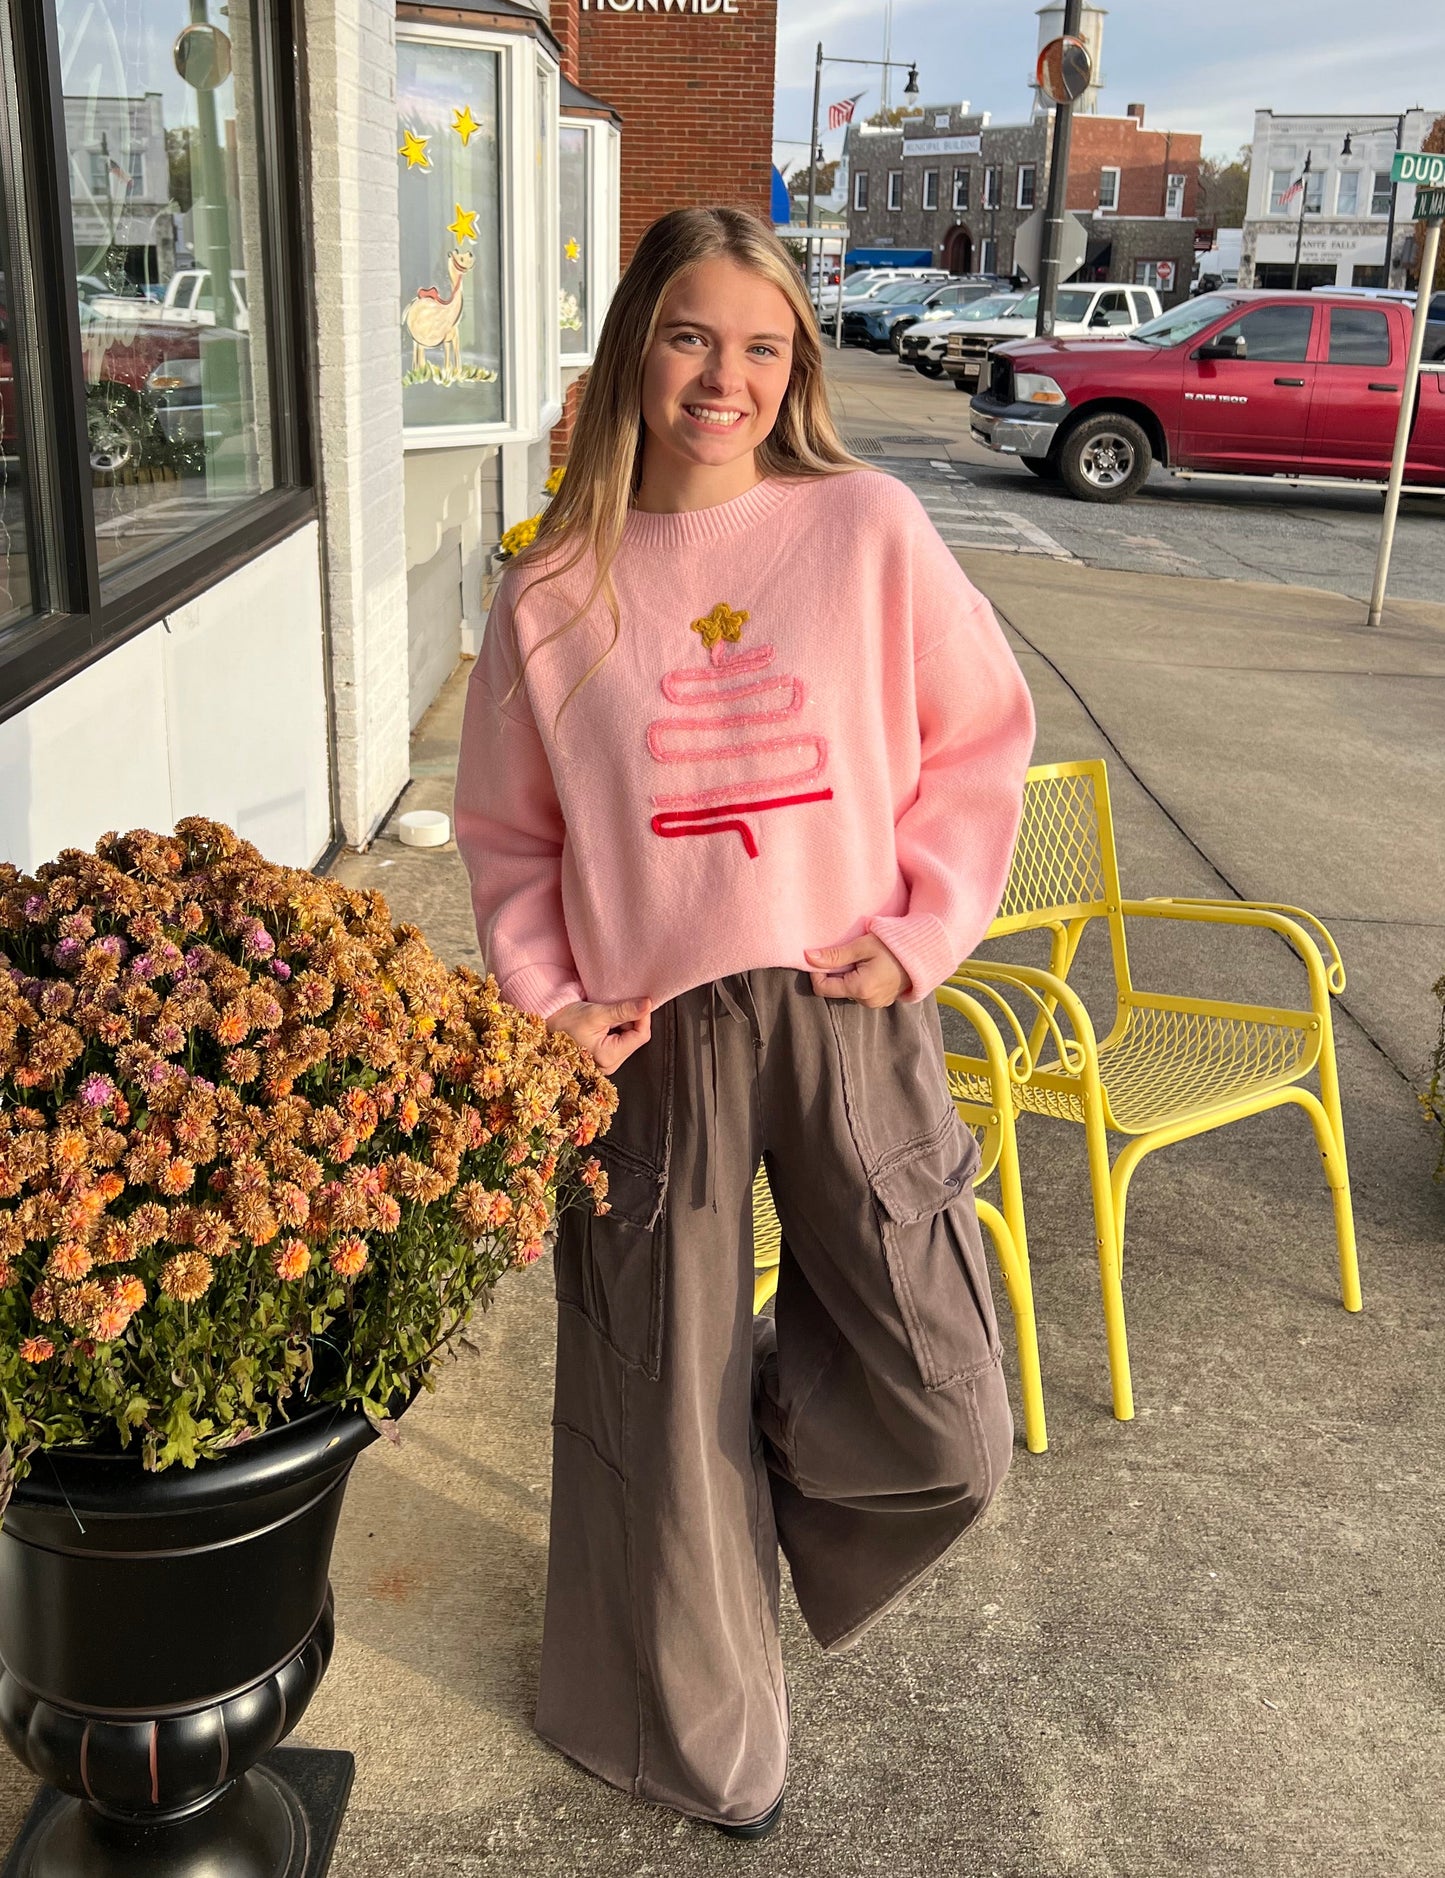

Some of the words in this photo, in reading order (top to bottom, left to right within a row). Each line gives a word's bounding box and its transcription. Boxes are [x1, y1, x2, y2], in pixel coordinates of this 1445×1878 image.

[1401, 155, 1445, 181] DUD
[1289, 240, 1327, 249] GANITE
[1185, 393, 1216, 401] RAM
